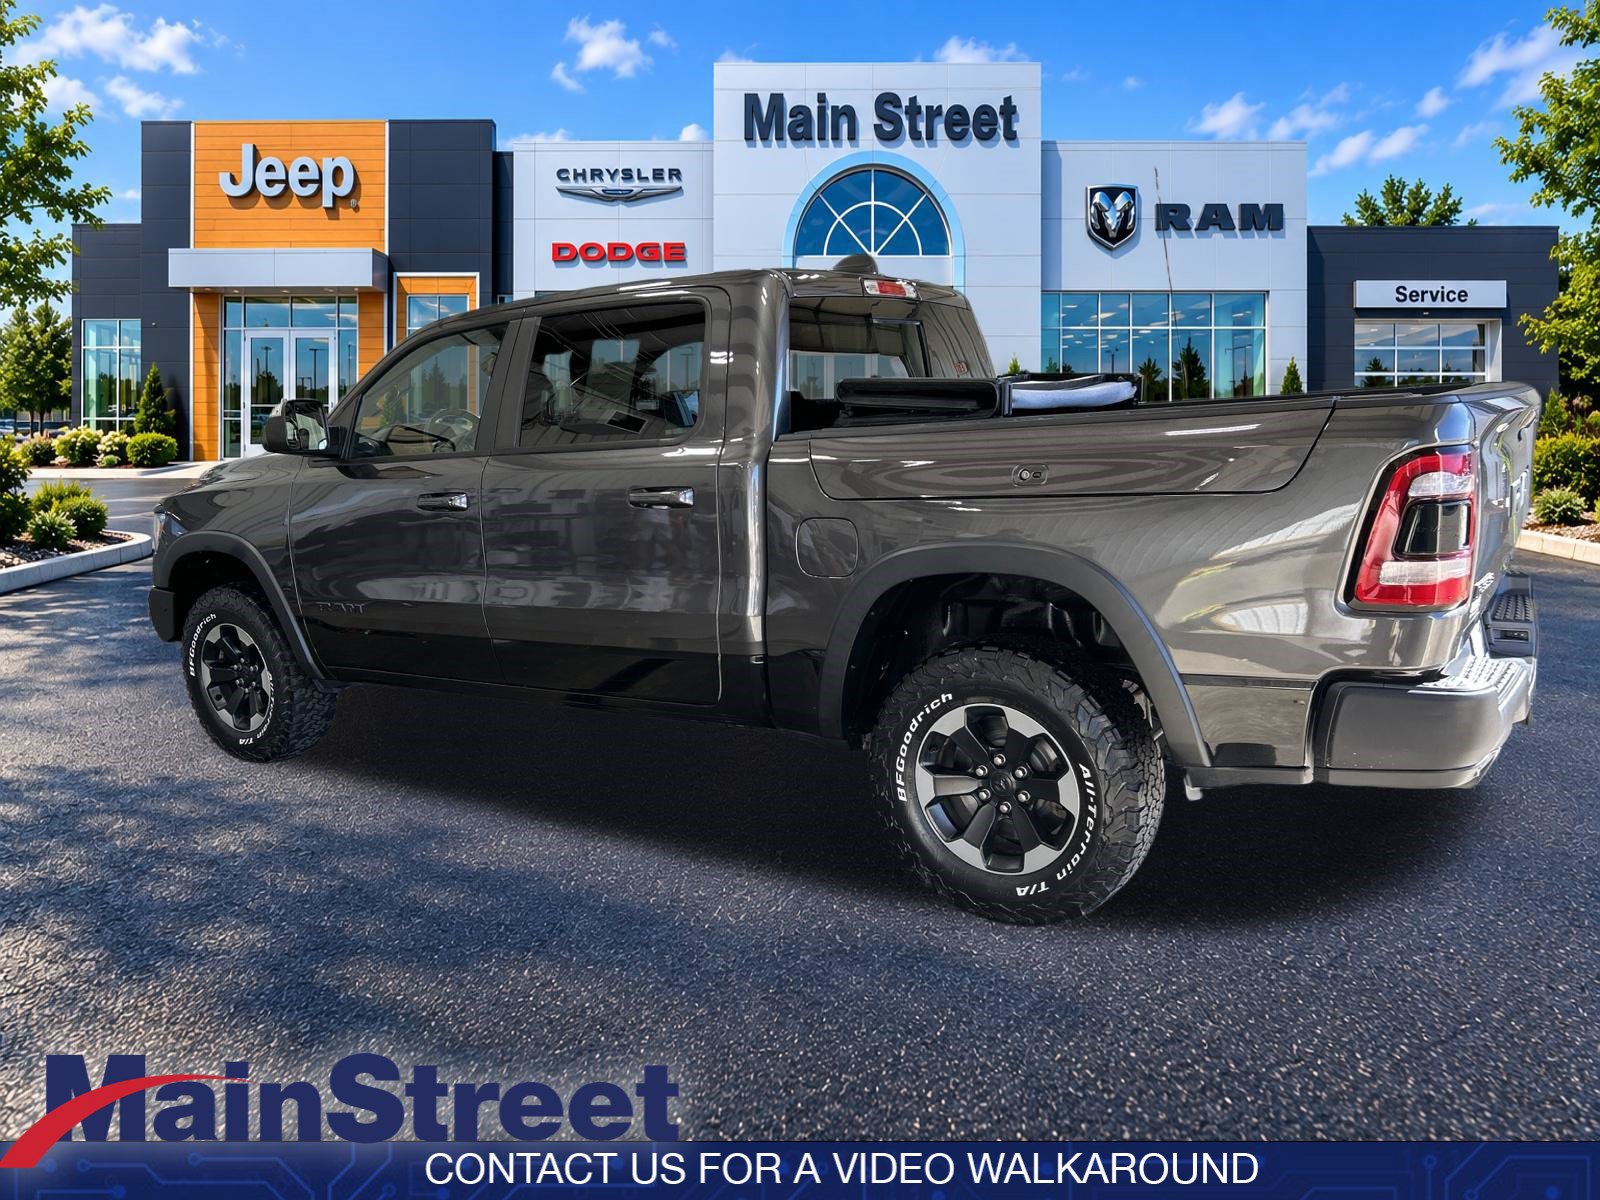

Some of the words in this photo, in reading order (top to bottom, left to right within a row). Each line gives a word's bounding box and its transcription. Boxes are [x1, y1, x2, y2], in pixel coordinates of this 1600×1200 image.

[743, 93, 857, 141] Main
[873, 92, 1018, 141] Street
[219, 143, 354, 208] Jeep
[556, 168, 683, 182] CHRYSLER
[1155, 203, 1284, 231] RAM
[551, 242, 687, 261] DODGE
[1395, 285, 1469, 303] Service
[896, 692, 953, 801] BFGoodrich
[1056, 762, 1098, 881] All-Terrain
[1016, 881, 1050, 896] T/A
